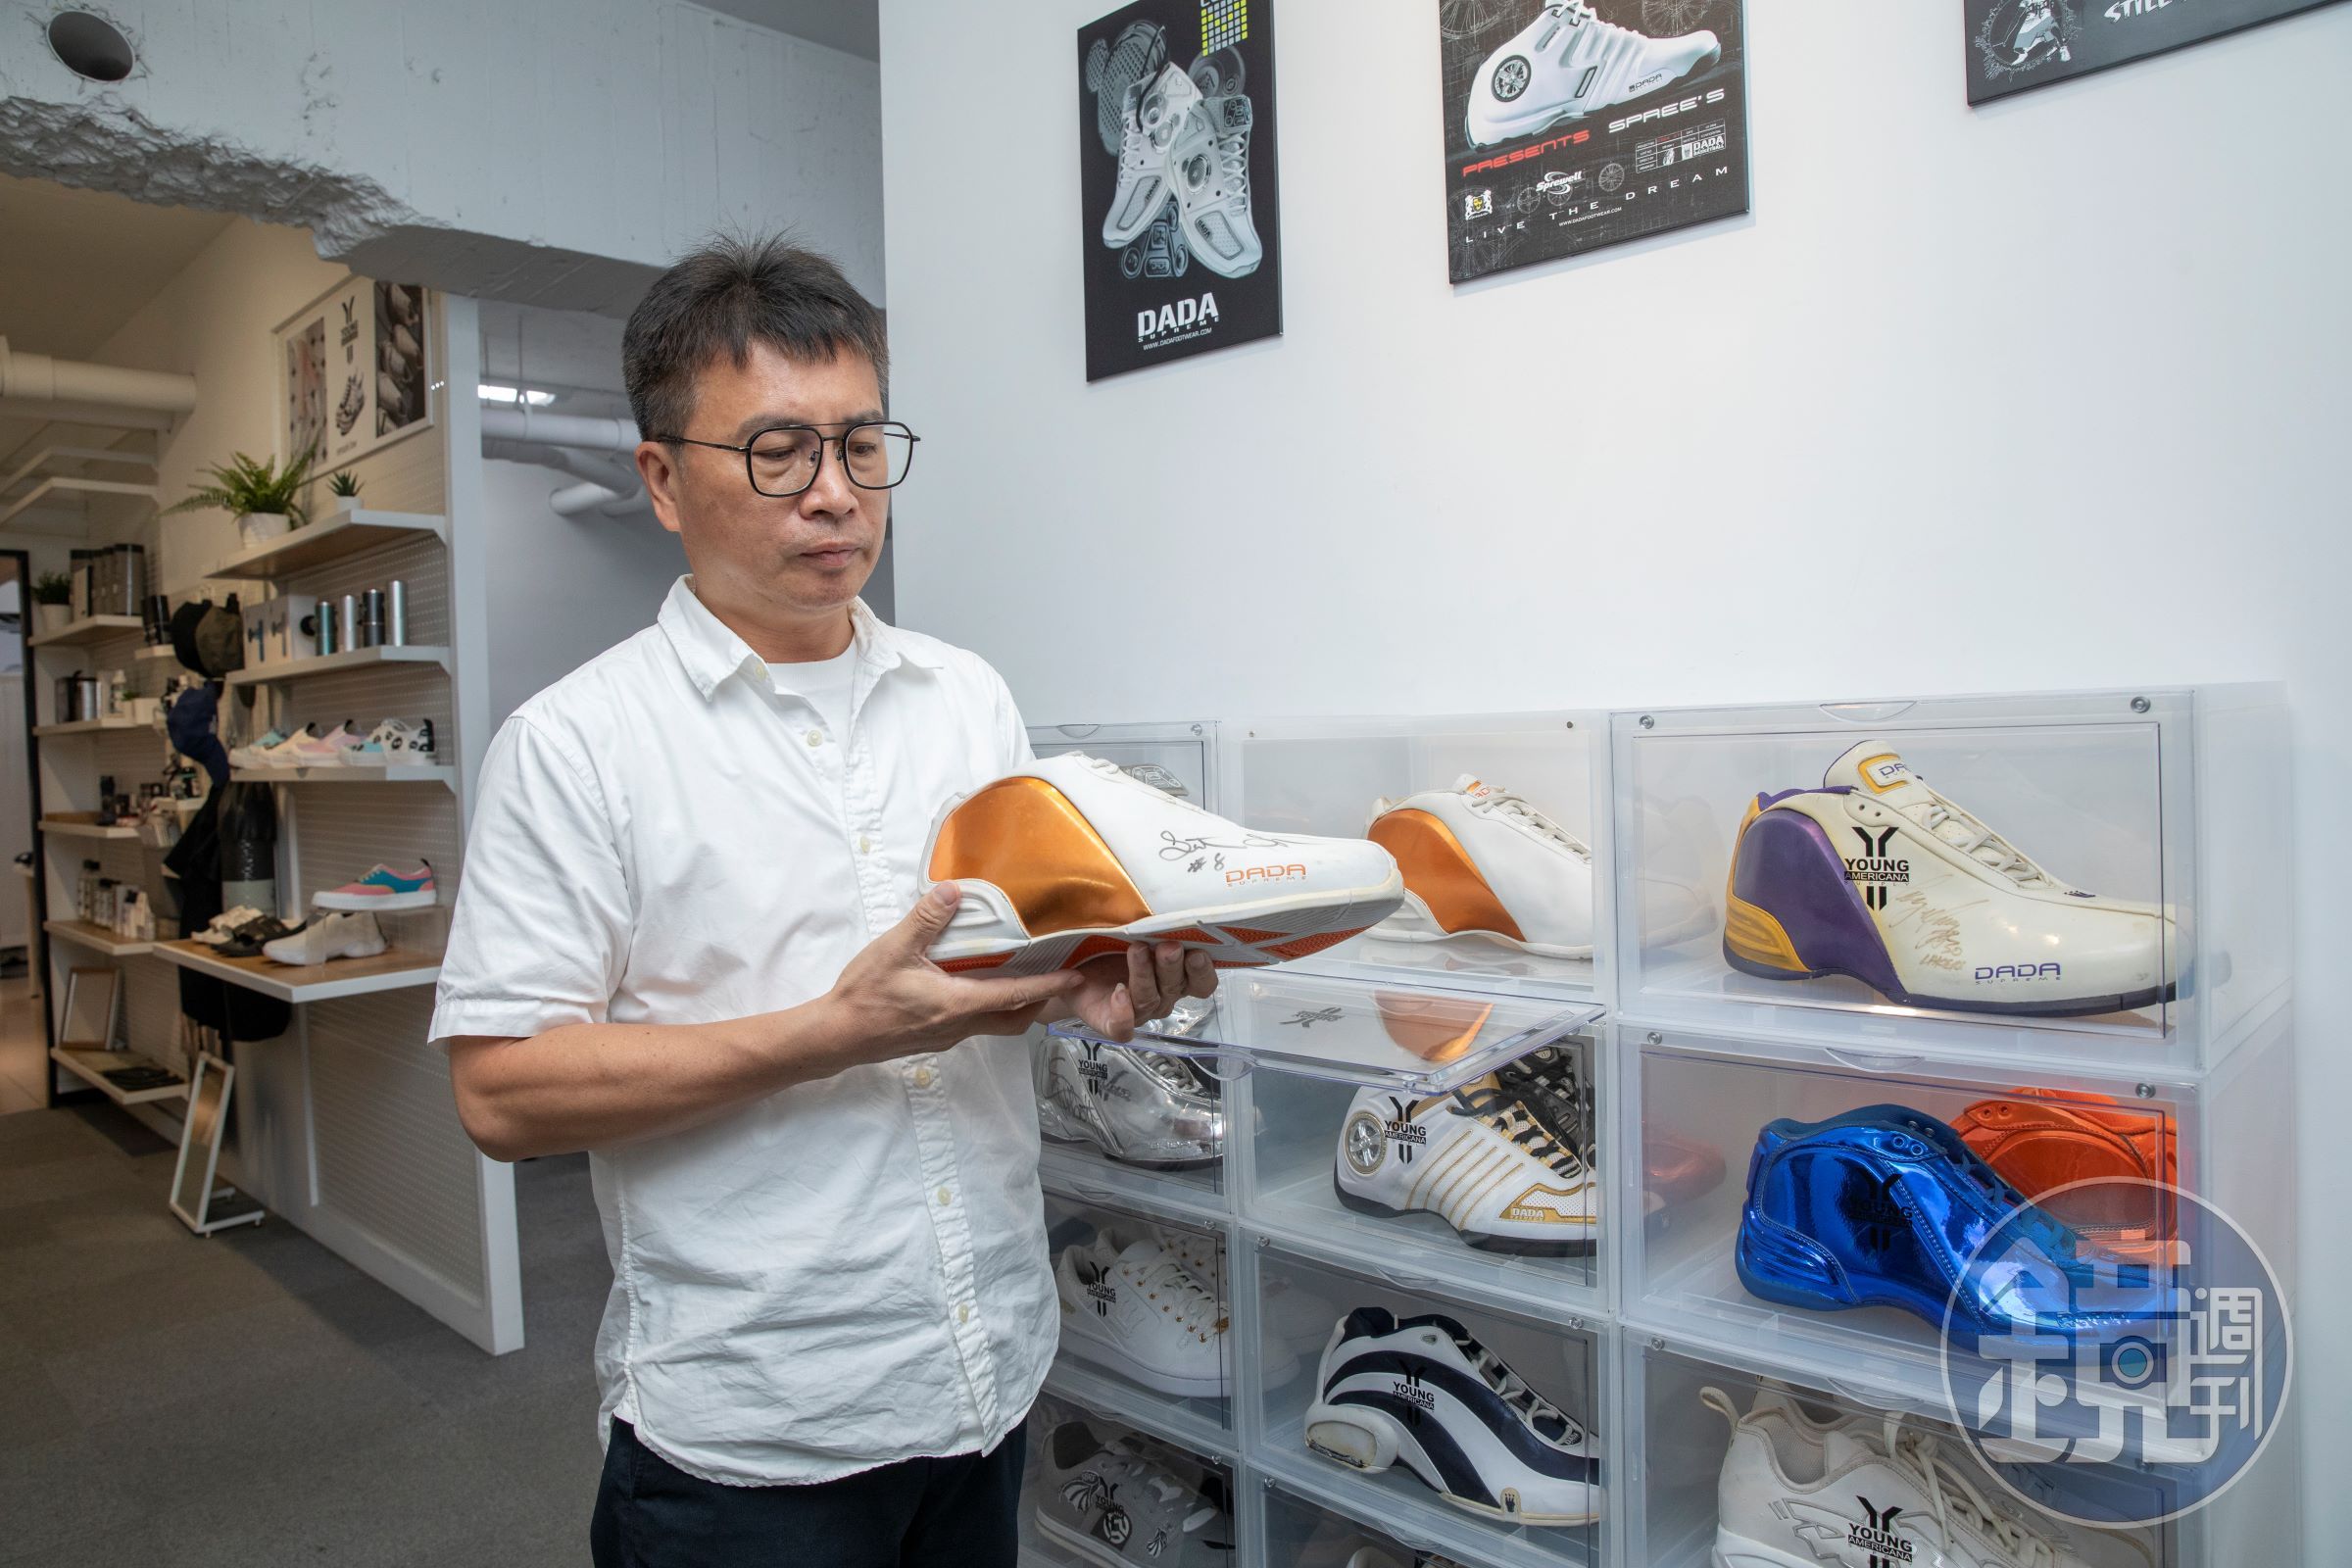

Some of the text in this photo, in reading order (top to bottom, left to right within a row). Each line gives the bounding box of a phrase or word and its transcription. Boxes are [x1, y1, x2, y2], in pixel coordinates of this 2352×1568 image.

[1462, 88, 1725, 176] PRESENTS SPREE'S
[1536, 171, 1583, 192] Sprewell
[1465, 166, 1728, 243] LIVE THE DREAM
[1558, 207, 1622, 227] WWW.DADAFOOTWEAR.COM
[1137, 292, 1219, 337] DADA
[1138, 316, 1219, 343] SUPREME
[1143, 326, 1212, 351] WWW.DADAFOOTWEAR.COM
[1226, 863, 1306, 883] DADA
[1845, 858, 1909, 872] YOUNG
[1844, 871, 1909, 882] AMERICANA
[1975, 962, 2061, 980] DADA
[1079, 1059, 1107, 1072] YOUNG
[1385, 1120, 1426, 1137] YOUNG
[1512, 1208, 1544, 1217] DADA
[1393, 1381, 1435, 1402] YOUNG
[1848, 1523, 1912, 1552] YOUNG
[1848, 1535, 1912, 1562] AMERICANA
